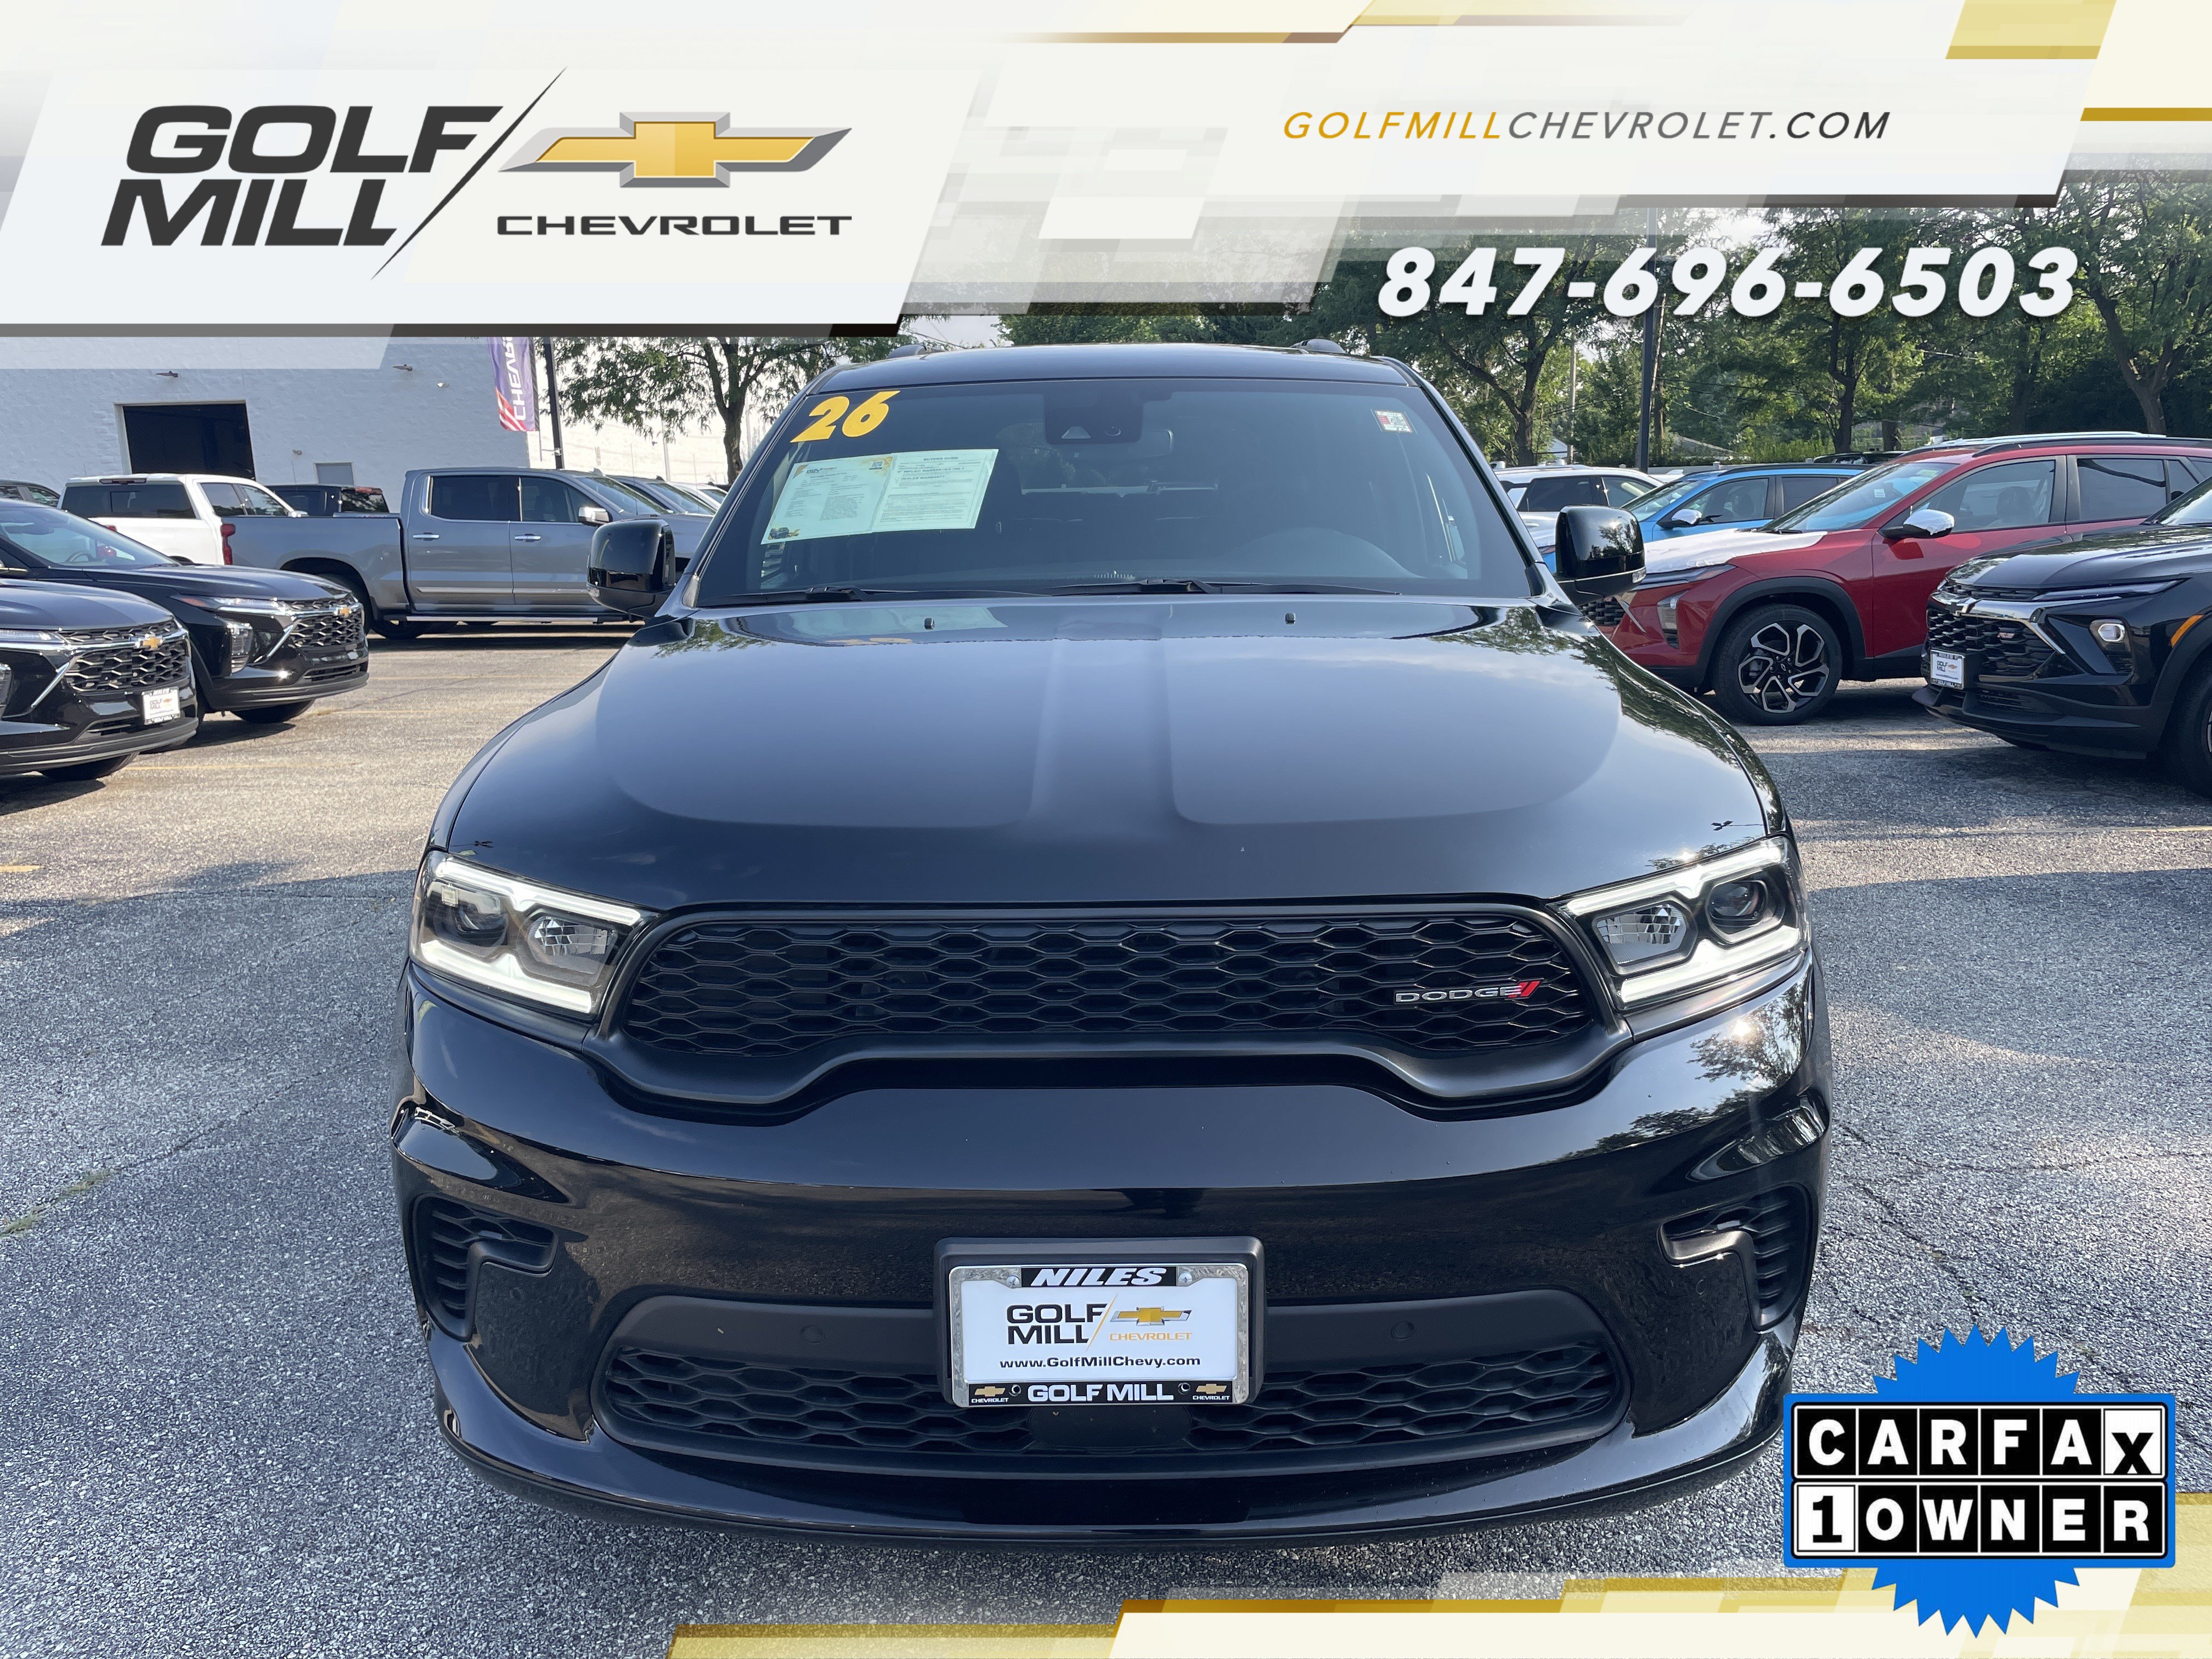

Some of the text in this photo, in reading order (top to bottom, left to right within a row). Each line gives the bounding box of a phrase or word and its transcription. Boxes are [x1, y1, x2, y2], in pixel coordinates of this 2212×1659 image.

[791, 391, 901, 443] 26
[1396, 985, 1522, 1003] DODGE
[1030, 1267, 1167, 1286] NILES
[1007, 1303, 1108, 1324] GOLF
[1007, 1325, 1089, 1345] MILL
[1109, 1331, 1193, 1341] CHEVROLET
[1000, 1356, 1201, 1368] www.GolfMillChevy.com
[1028, 1384, 1174, 1402] GOLF MILL
